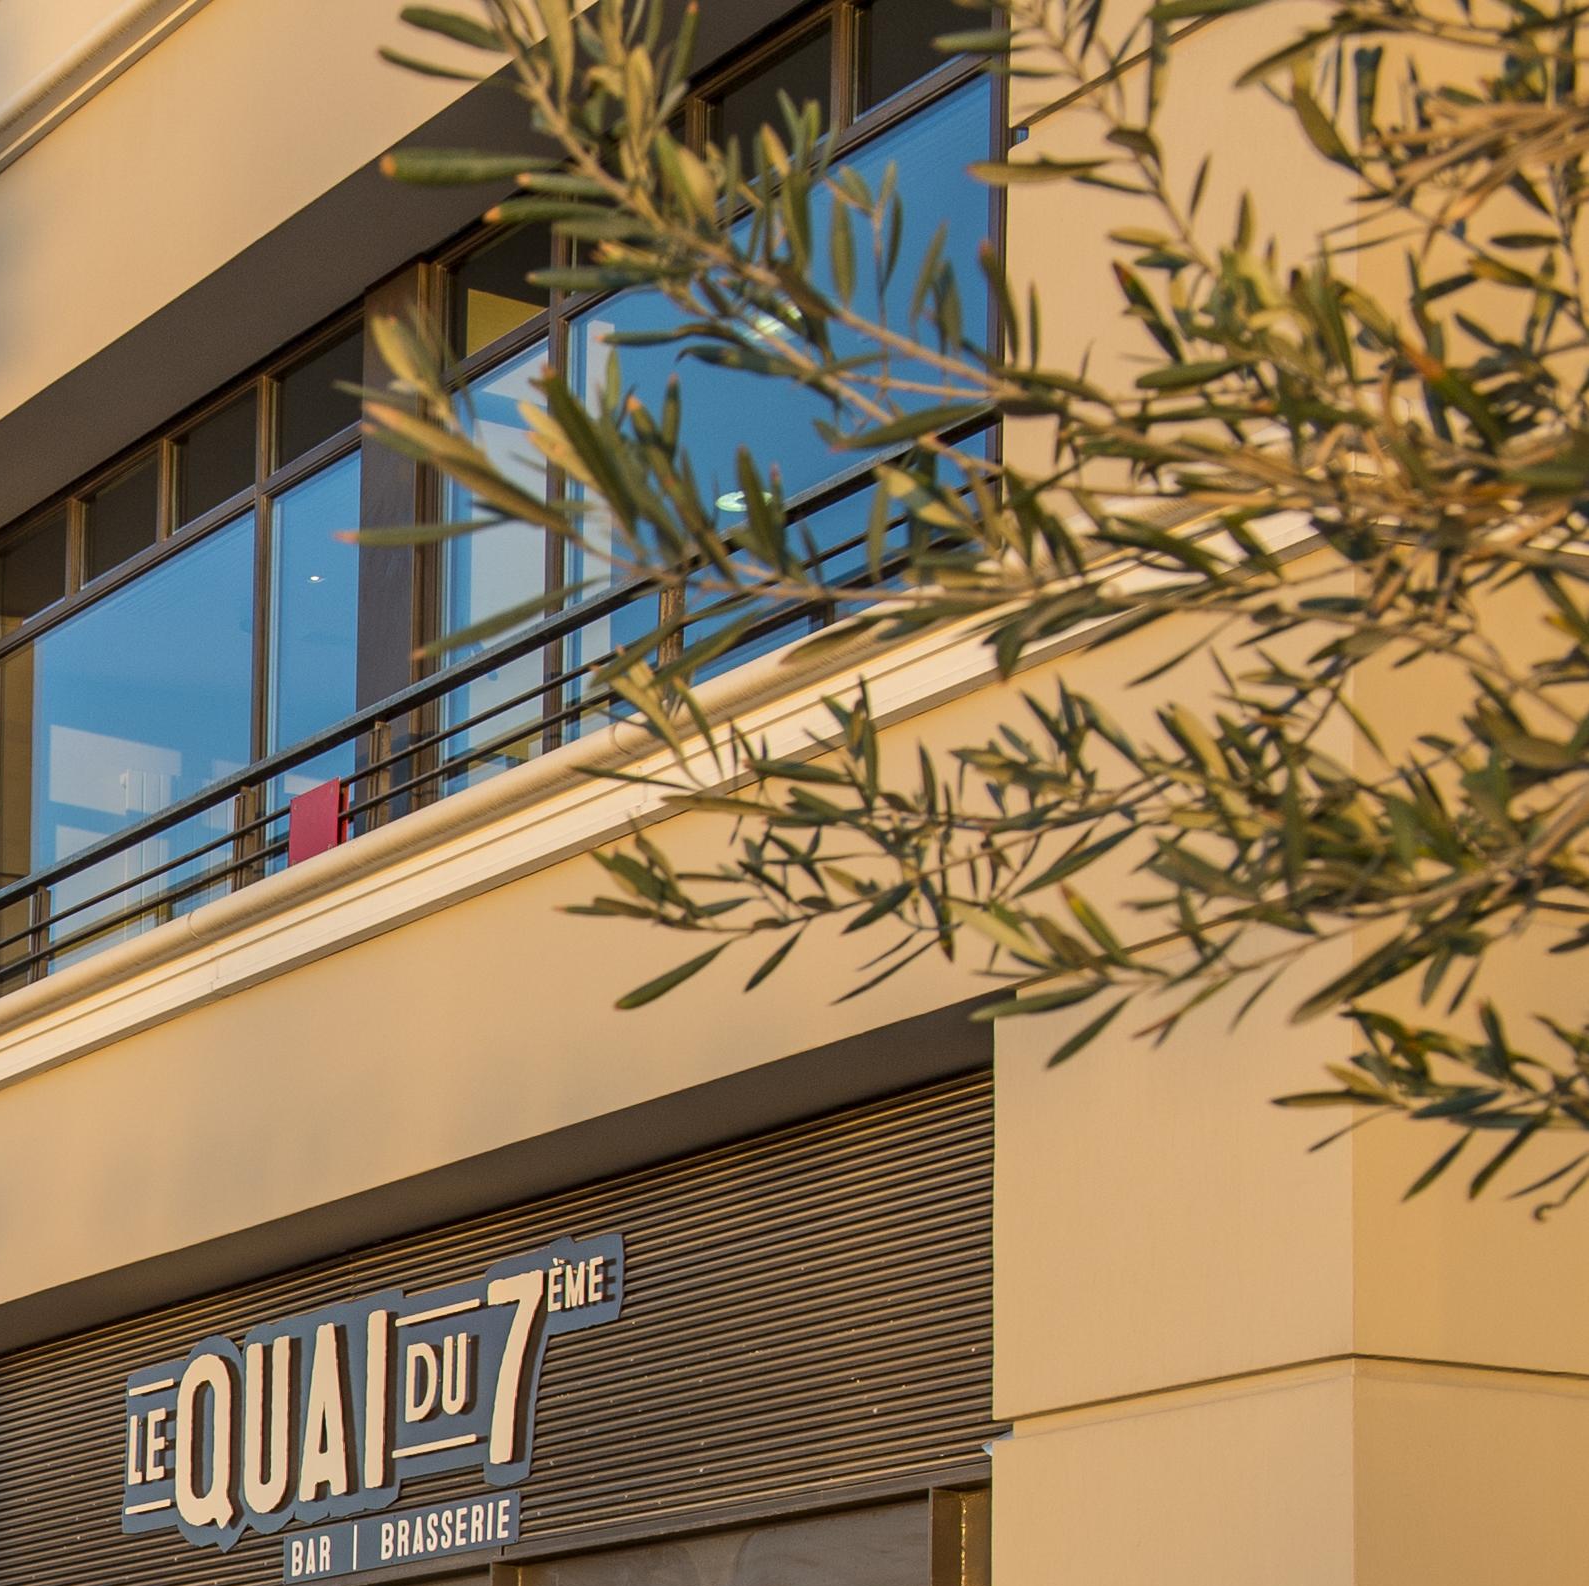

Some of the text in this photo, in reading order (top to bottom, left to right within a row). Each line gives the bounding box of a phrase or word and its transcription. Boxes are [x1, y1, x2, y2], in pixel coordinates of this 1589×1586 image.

[127, 1406, 168, 1486] LE
[175, 1308, 388, 1530] QUAI
[405, 1330, 468, 1423] DU
[290, 1498, 511, 1578] BAR BRASSERIE
